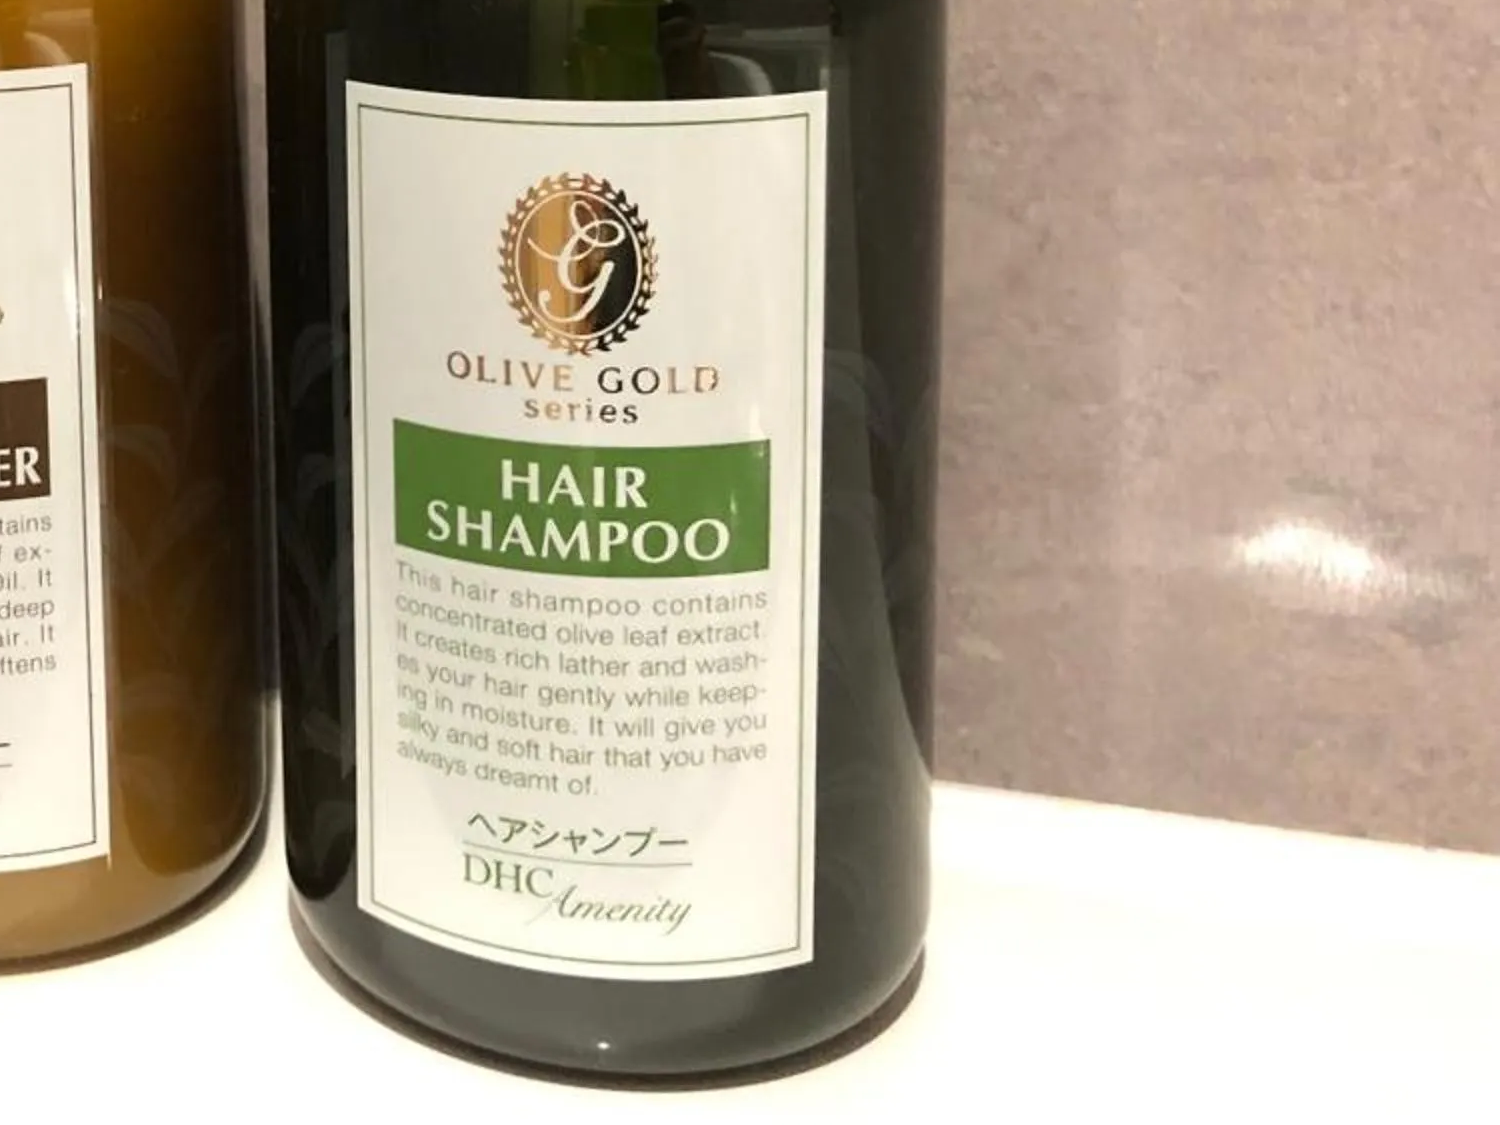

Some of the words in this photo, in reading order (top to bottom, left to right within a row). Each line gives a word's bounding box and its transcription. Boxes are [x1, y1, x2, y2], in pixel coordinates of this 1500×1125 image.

[446, 351, 575, 392] OLIVE
[597, 365, 720, 396] GOLD
[524, 398, 639, 424] series
[501, 458, 649, 509] HAIR
[14, 545, 53, 563] ex-
[426, 499, 731, 564] SHAMPOO
[37, 567, 52, 587] It
[396, 560, 441, 592] This
[451, 576, 499, 603] hair
[509, 588, 641, 618] shampoo
[652, 591, 767, 616] contains
[40, 623, 54, 643] It
[395, 594, 547, 640] concentrated
[556, 623, 614, 647] olive
[623, 626, 668, 647] leaf
[415, 630, 496, 663] creates
[505, 649, 550, 671] rich
[558, 652, 630, 676] lather
[639, 655, 687, 677] and
[695, 651, 767, 675] wash-
[397, 683, 427, 711] ing
[435, 690, 454, 713] in
[462, 701, 578, 735] moisture.
[589, 716, 604, 737] It
[614, 717, 655, 738] will
[664, 717, 715, 742] give
[724, 714, 767, 739] you
[426, 664, 475, 688] your
[484, 672, 529, 698] hair
[538, 686, 616, 712] gently
[625, 686, 690, 707] while
[698, 683, 767, 706] keep-
[396, 739, 467, 776] always
[474, 763, 559, 793] dreamt
[397, 711, 439, 742] silky
[446, 727, 489, 751] and
[497, 739, 540, 760] soft
[549, 741, 595, 765] hair
[604, 747, 651, 768] that
[660, 750, 704, 772] you
[712, 743, 767, 765] have
[463, 852, 553, 899] DHC
[550, 885, 692, 935] Amenity
